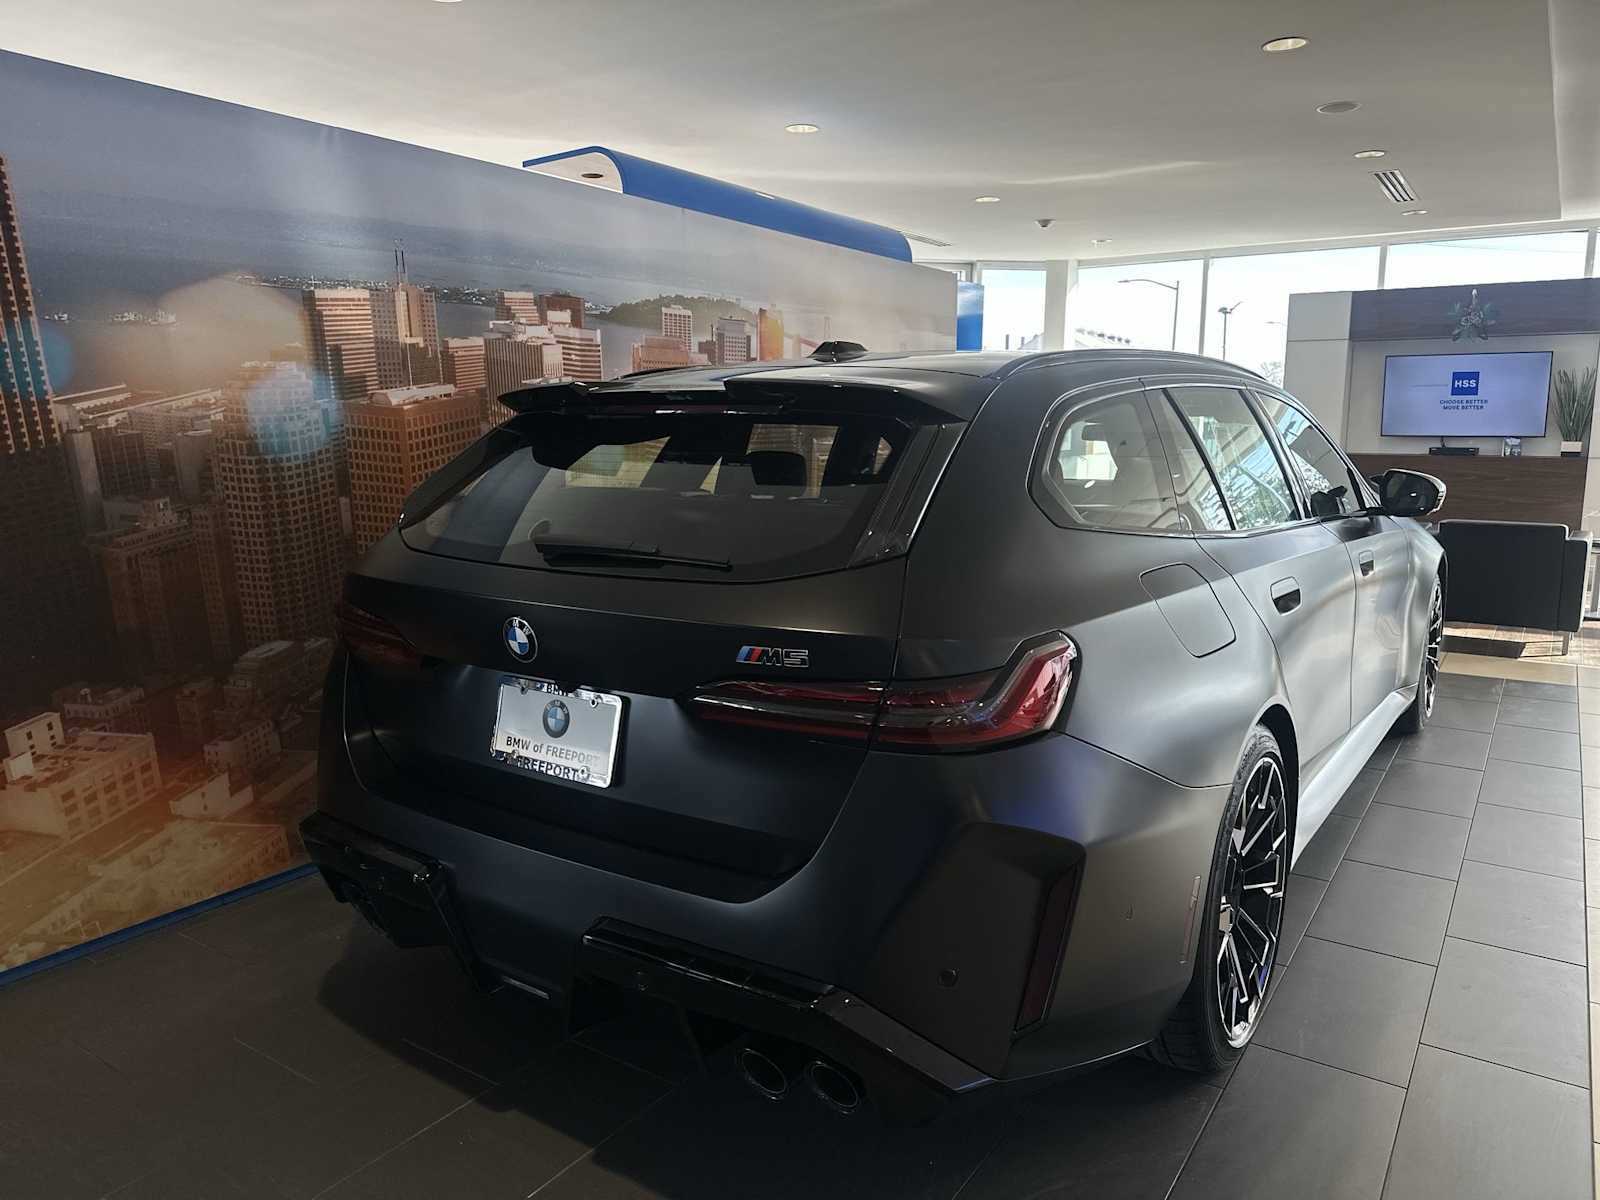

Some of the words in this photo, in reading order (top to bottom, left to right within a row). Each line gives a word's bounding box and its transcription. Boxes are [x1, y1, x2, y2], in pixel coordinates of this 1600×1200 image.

[1454, 379, 1477, 388] HSS
[760, 647, 809, 668] M5
[506, 736, 532, 751] BMW
[533, 743, 543, 754] of
[545, 744, 601, 765] FREEPORT
[517, 757, 579, 781] FREEPORT
